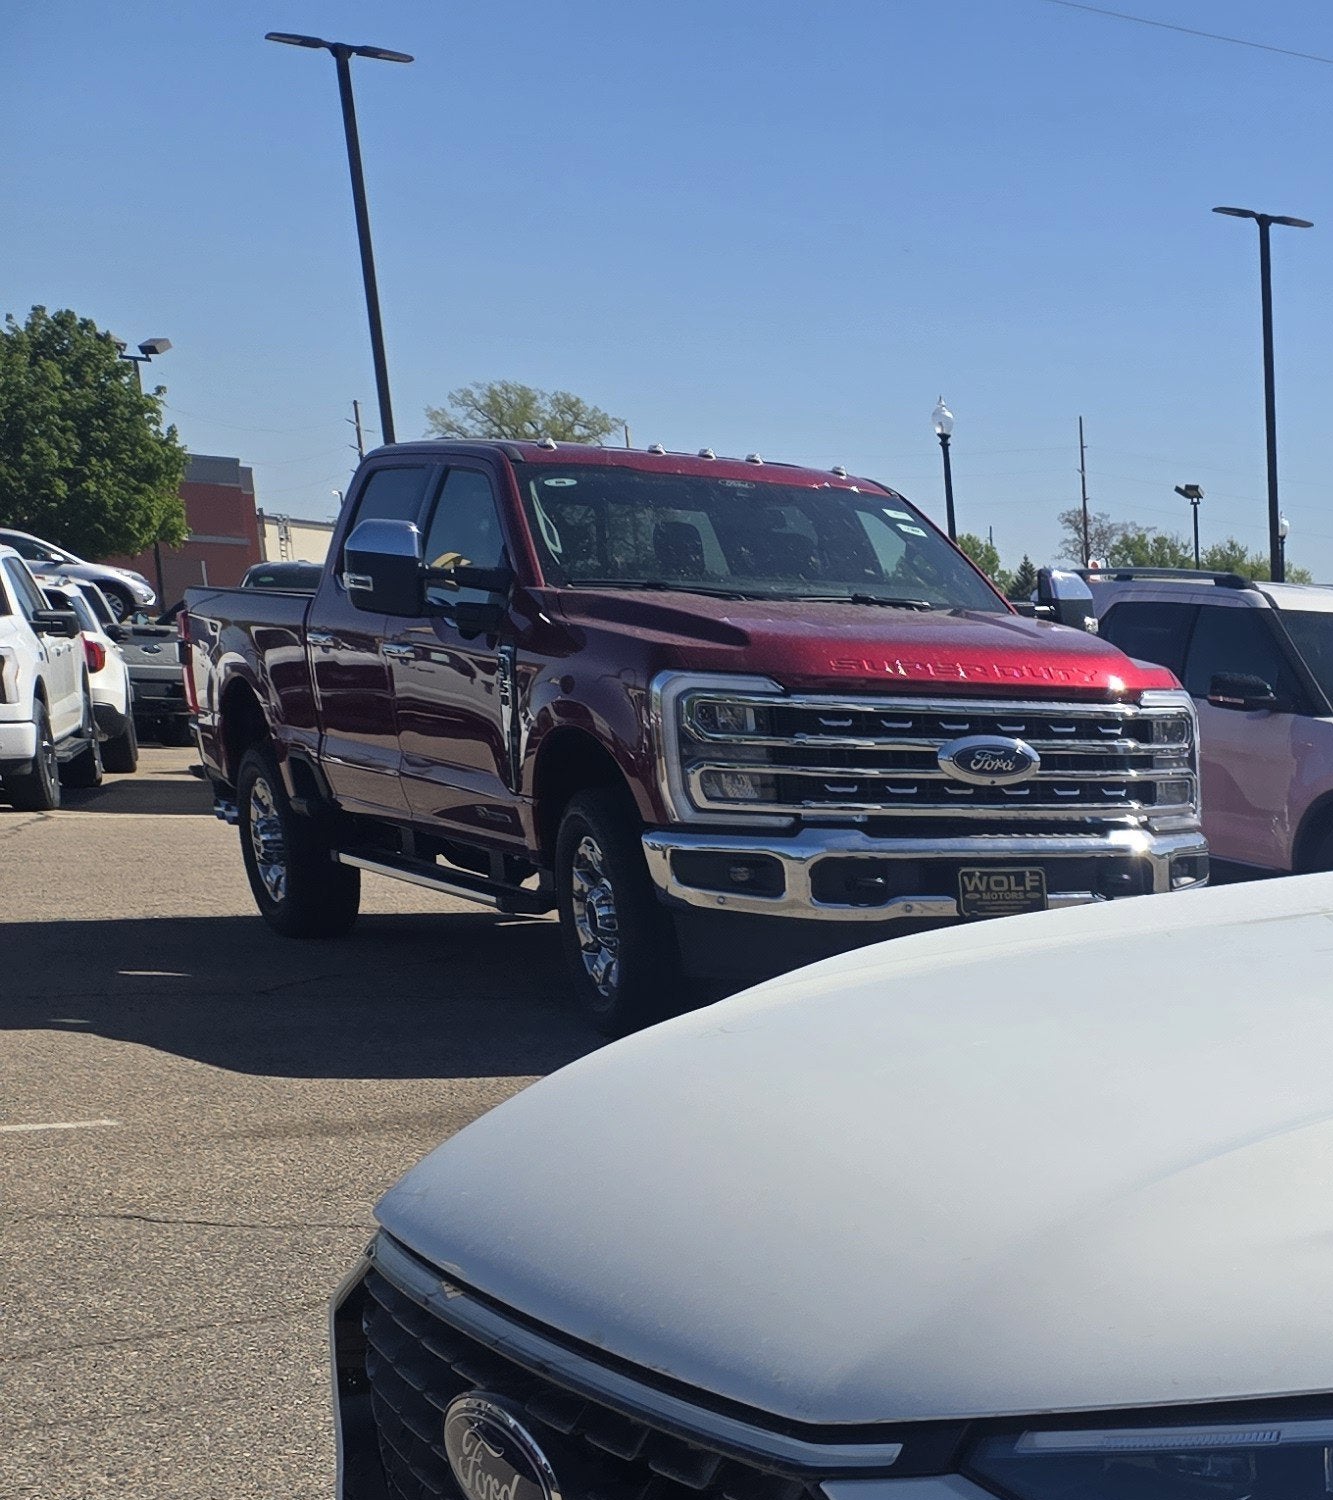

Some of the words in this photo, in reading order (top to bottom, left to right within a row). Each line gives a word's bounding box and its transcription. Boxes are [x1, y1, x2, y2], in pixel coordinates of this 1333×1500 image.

[829, 657, 988, 679] SUPER
[991, 664, 1098, 683] DUTY
[970, 750, 1016, 771] Ford
[963, 875, 1041, 891] WOLF
[982, 891, 1025, 900] MOTORS
